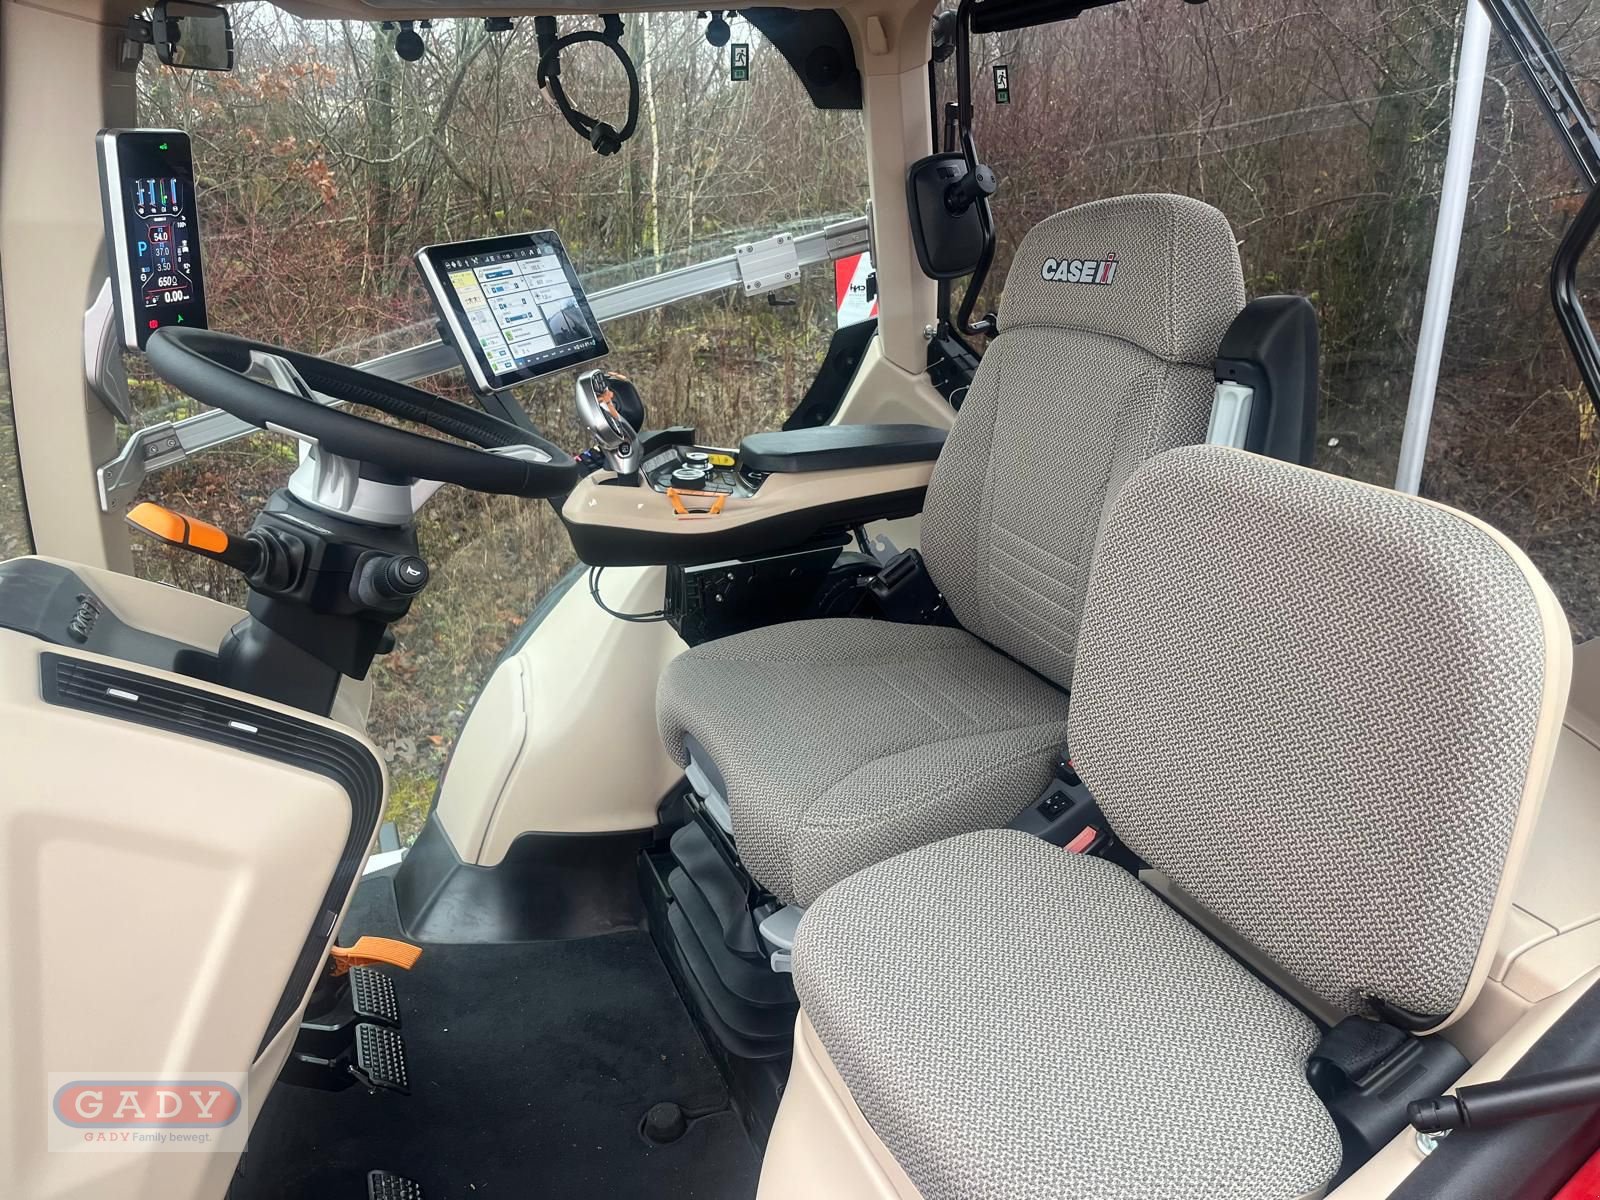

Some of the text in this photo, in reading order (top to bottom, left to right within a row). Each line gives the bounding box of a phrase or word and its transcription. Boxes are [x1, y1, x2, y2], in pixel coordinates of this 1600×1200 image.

[153, 232, 168, 241] 54.0
[138, 241, 148, 256] P
[155, 247, 169, 256] 37.0
[157, 262, 171, 272] 3.50
[1041, 257, 1097, 283] CASE
[158, 276, 172, 287] 650
[164, 290, 183, 303] 0.00
